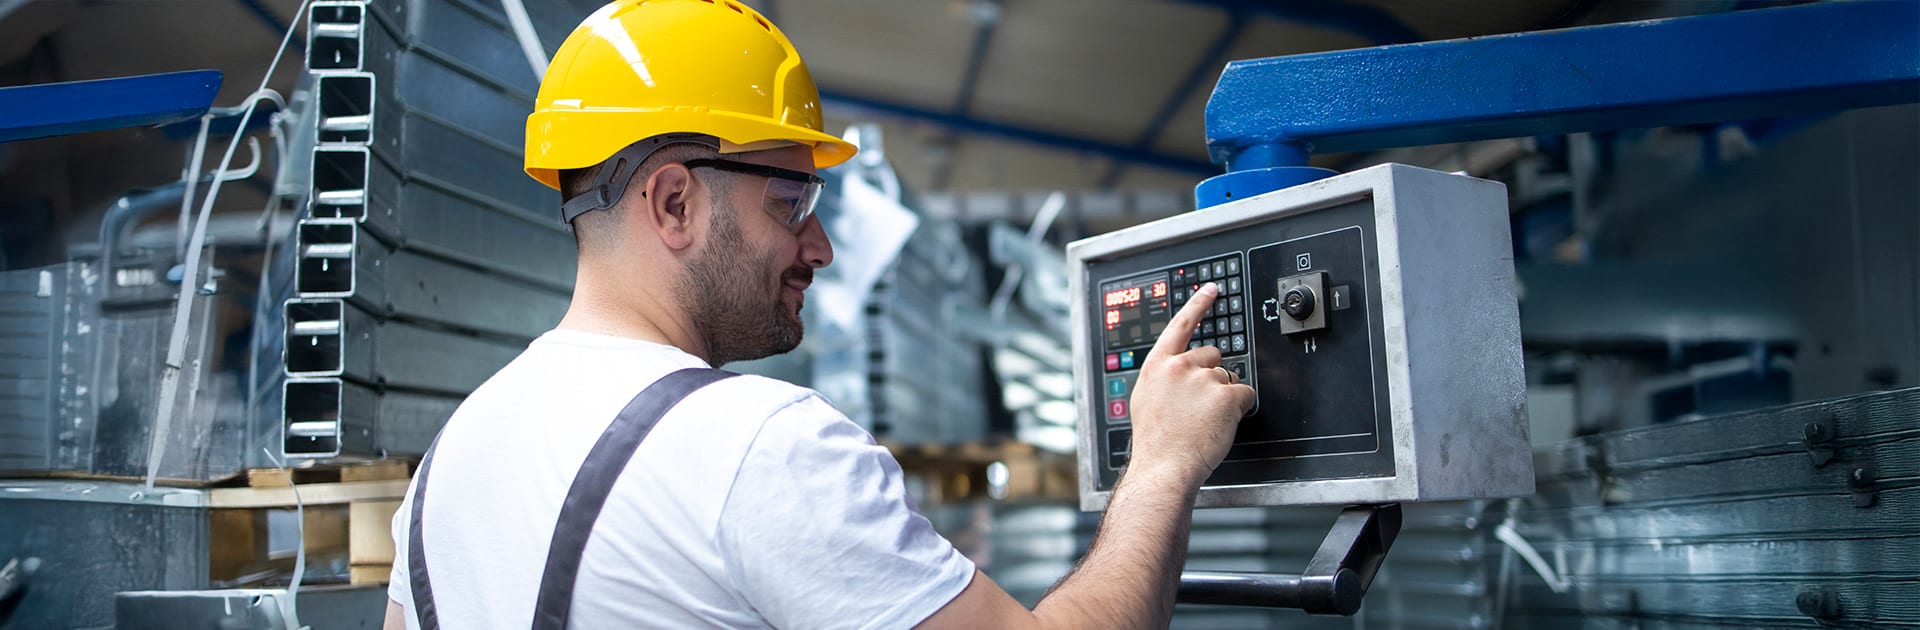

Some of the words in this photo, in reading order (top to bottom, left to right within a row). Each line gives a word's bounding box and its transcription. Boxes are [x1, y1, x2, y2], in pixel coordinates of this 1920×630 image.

[1216, 265, 1222, 274] 8
[1231, 262, 1236, 271] 9
[1202, 267, 1208, 277] 7
[1218, 283, 1223, 292] 5
[1231, 281, 1237, 290] 6
[1175, 292, 1182, 300] F2
[1218, 303, 1224, 311] 2
[1232, 300, 1238, 309] 3
[1220, 321, 1225, 330] 0
[1220, 340, 1227, 349] C
